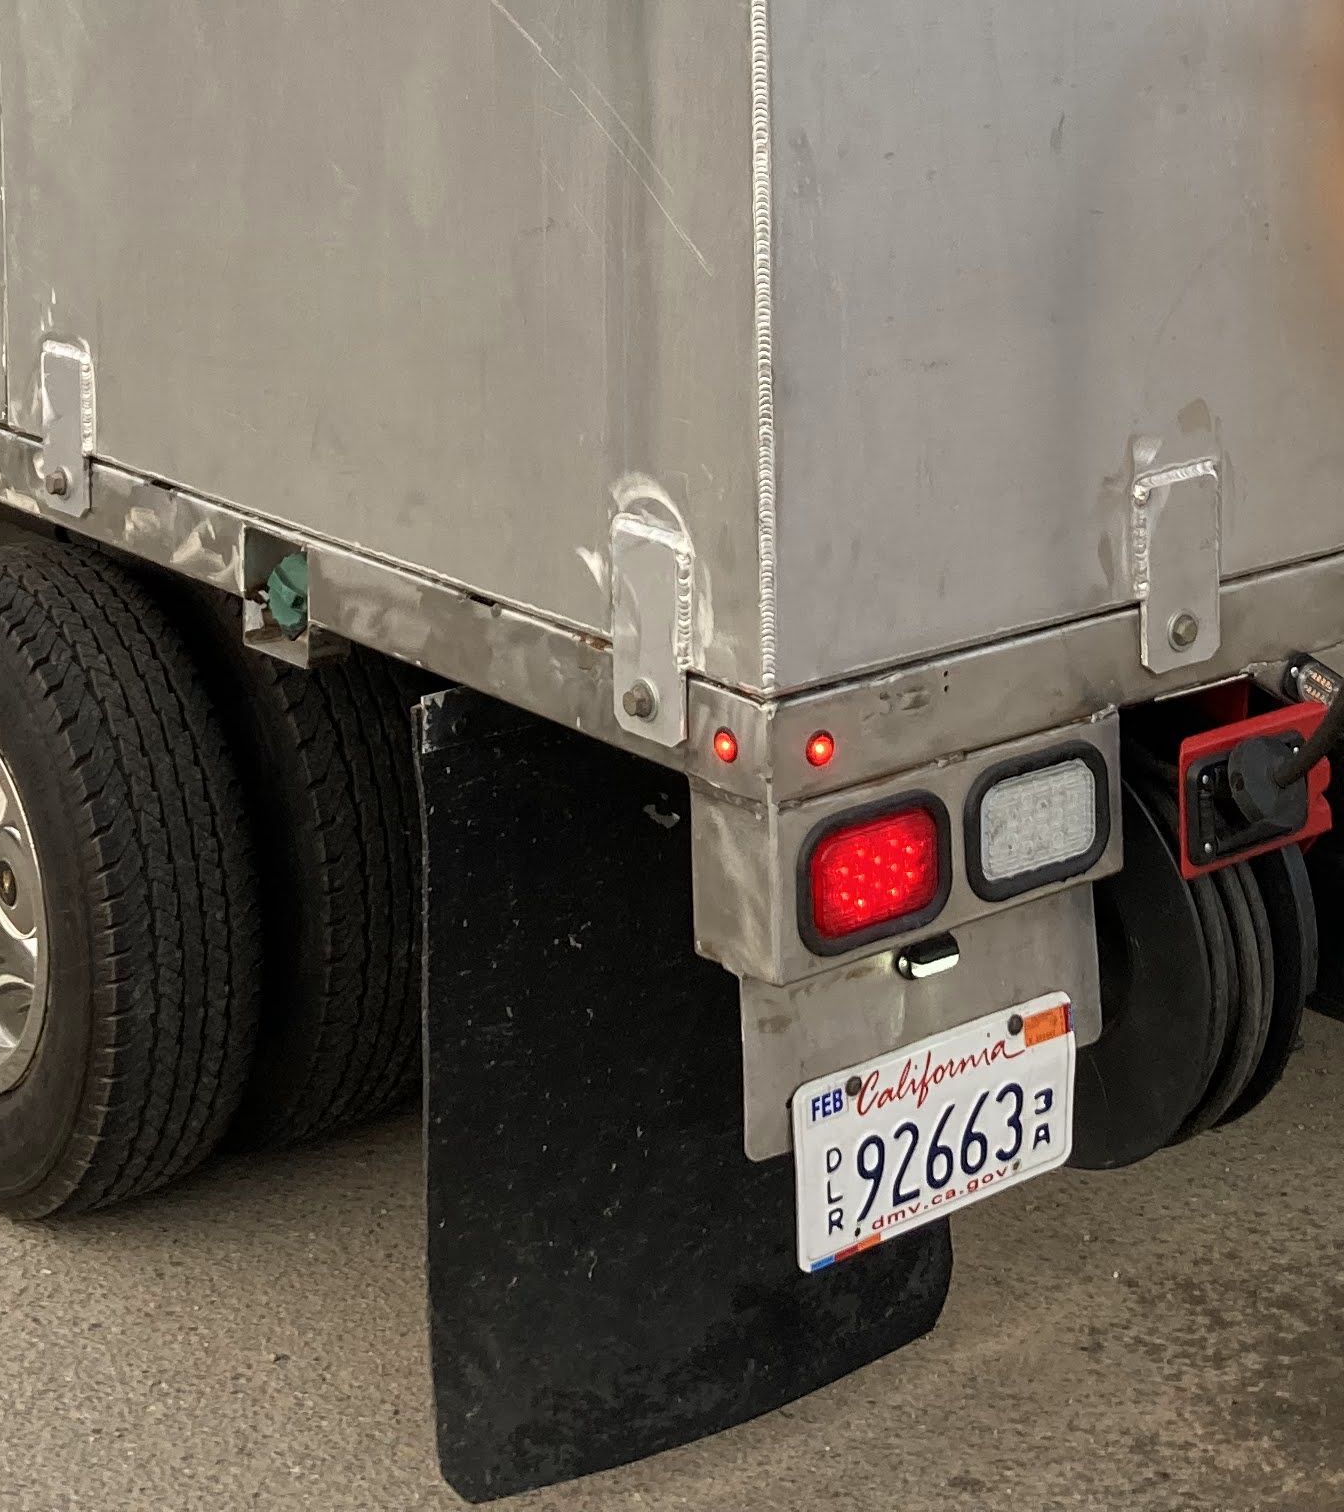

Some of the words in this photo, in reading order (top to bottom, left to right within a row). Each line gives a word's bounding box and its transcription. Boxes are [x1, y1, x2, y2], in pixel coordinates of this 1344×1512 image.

[810, 1087, 844, 1122] FEB
[856, 1032, 1026, 1117] California
[856, 1081, 1024, 1223] 92663
[871, 1166, 1008, 1231] dmv.ca.gov
